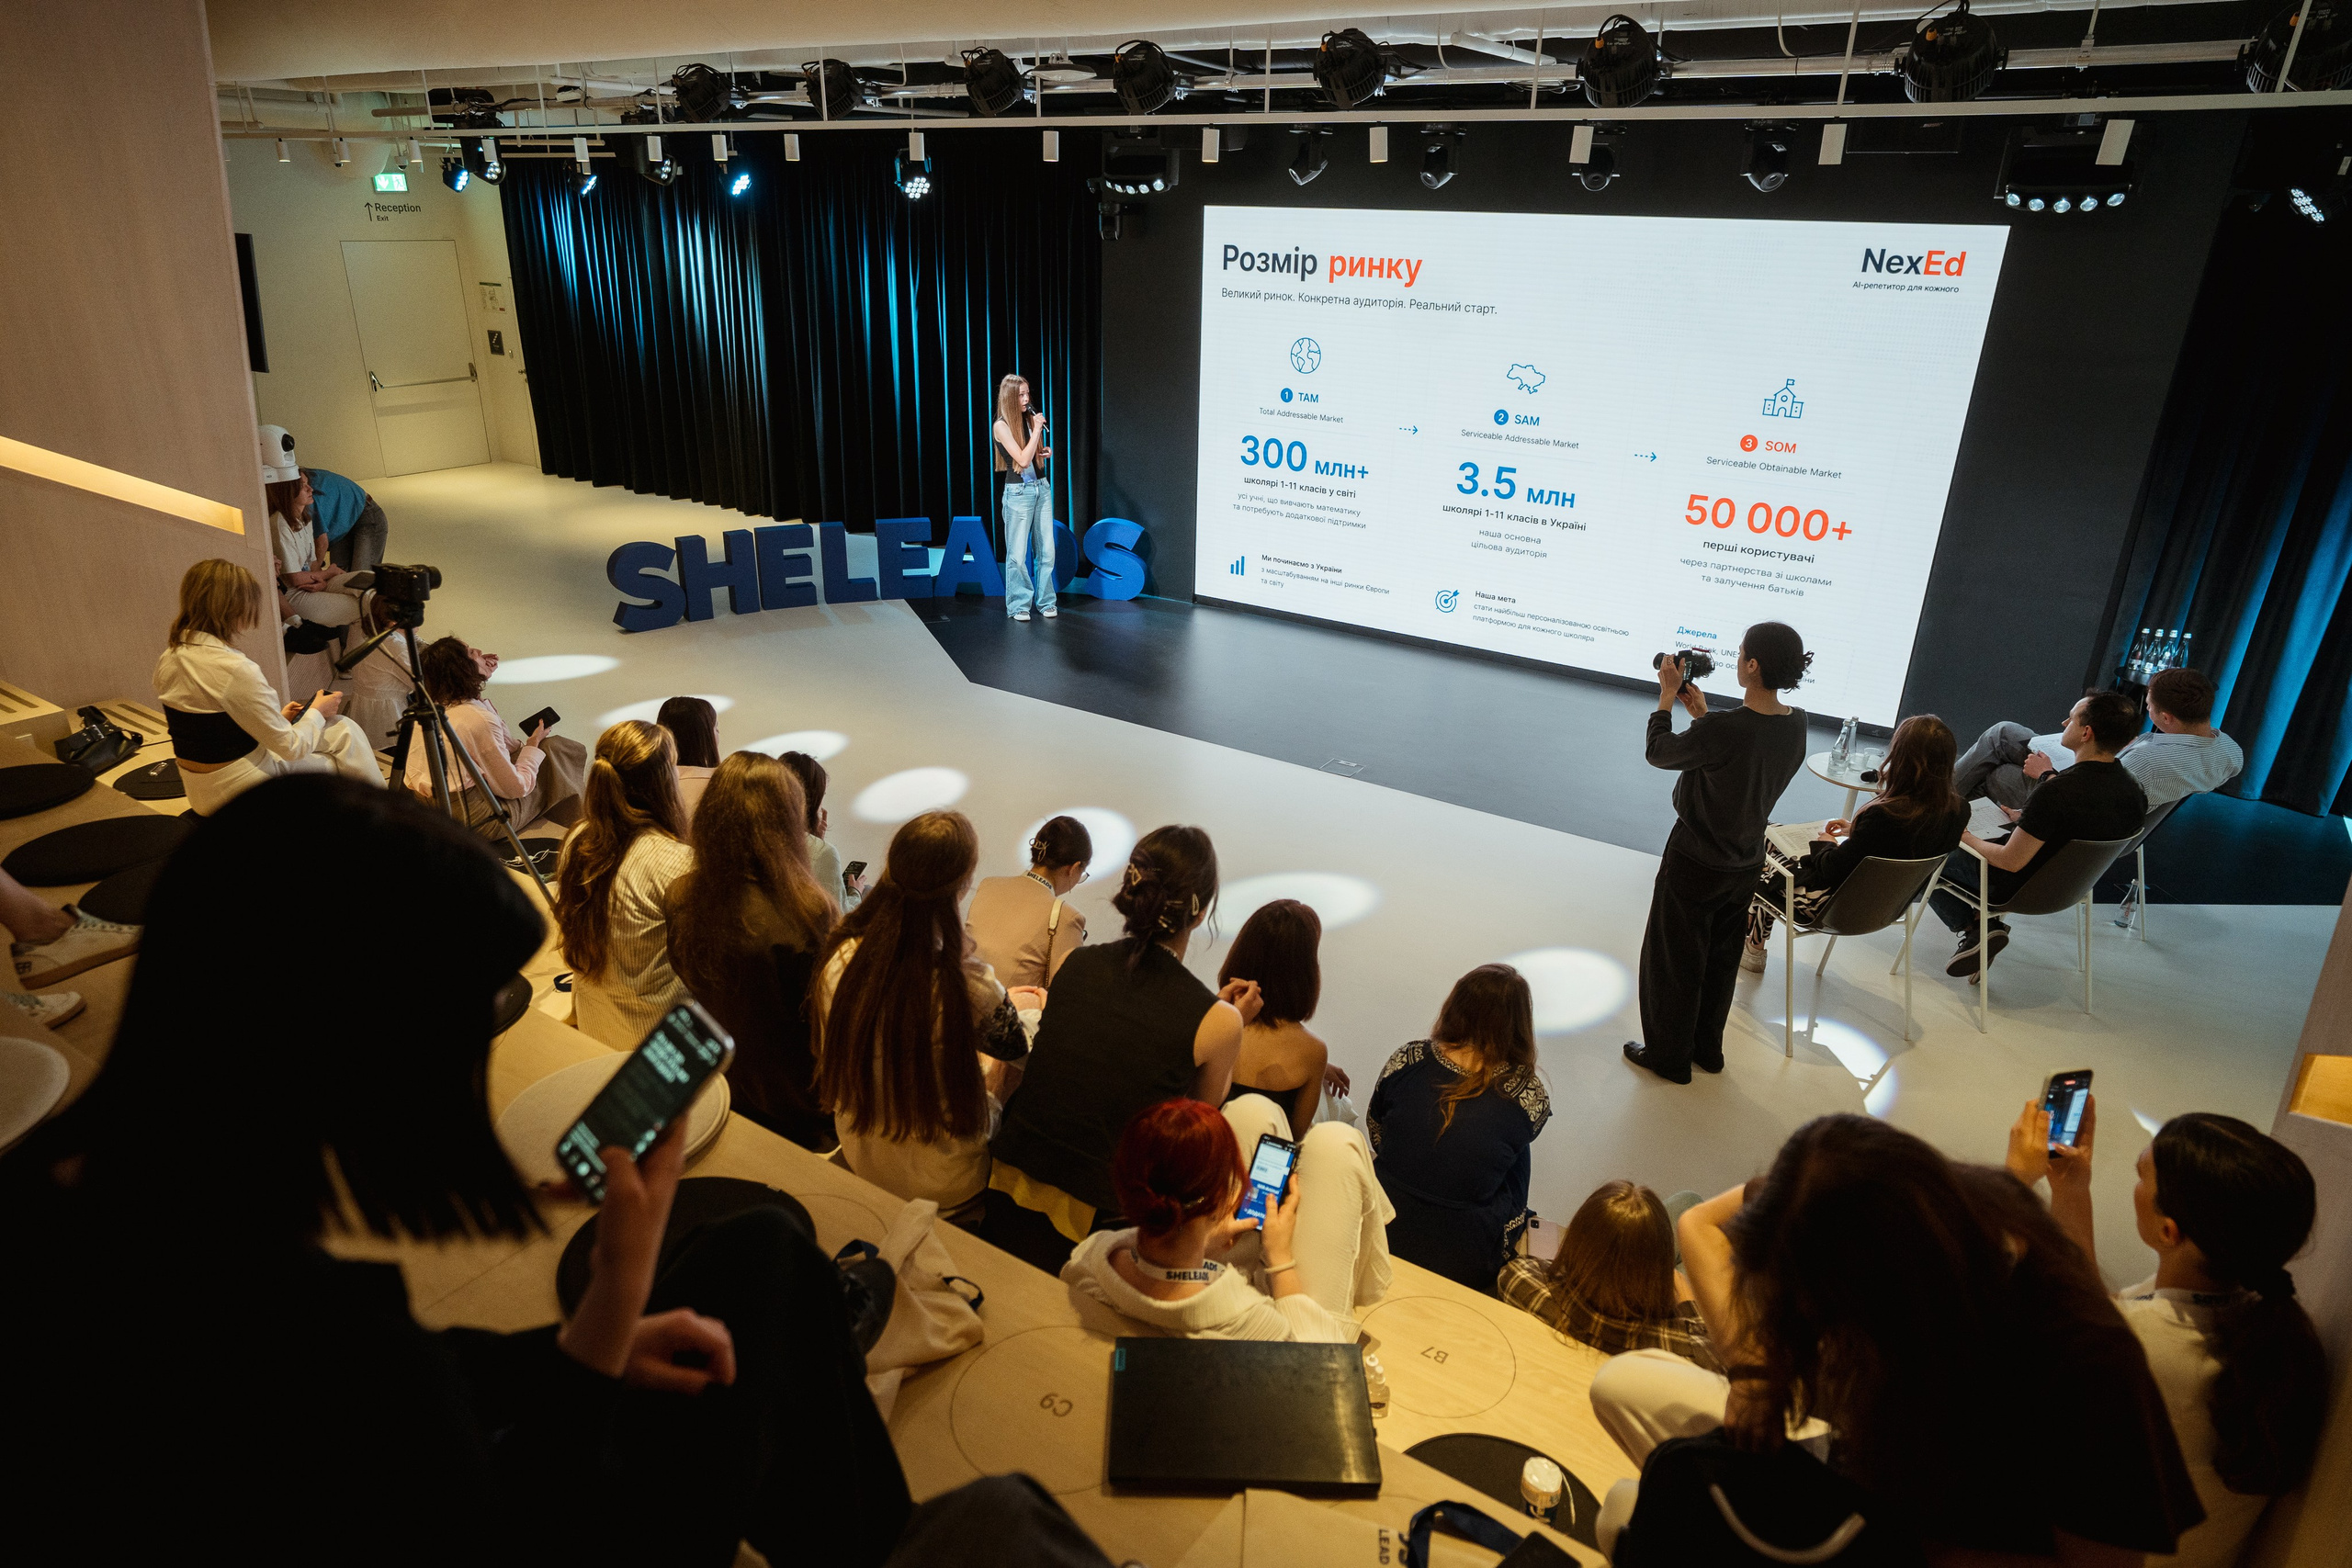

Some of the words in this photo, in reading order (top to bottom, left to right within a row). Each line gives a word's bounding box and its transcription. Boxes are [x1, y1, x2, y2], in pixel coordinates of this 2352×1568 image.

[375, 203, 421, 214] Reception
[1223, 244, 1317, 281] Розмір
[1329, 254, 1423, 288] ринку
[1861, 248, 1967, 276] NexEd
[1852, 281, 1905, 291] AI-репетитор
[1907, 284, 1922, 292] для
[1924, 285, 1959, 293] кожного
[1221, 288, 1261, 301] Великий
[1263, 290, 1295, 303] ринок.
[1298, 291, 1351, 308] Конкретна
[1353, 296, 1407, 309] аудиторія.
[1409, 298, 1461, 313] Реальний
[1464, 302, 1498, 315] старт.
[1298, 392, 1319, 403] TAM
[1259, 407, 1275, 416] Total
[1277, 410, 1317, 421] Addressable
[1319, 414, 1344, 423] Market
[1514, 414, 1540, 426] SAM
[1461, 428, 1503, 441] Serviceable
[1504, 434, 1551, 446] Addressable
[1552, 439, 1579, 449] Market
[1765, 440, 1797, 454] SOM
[1240, 434, 1307, 472] 300
[1315, 460, 1369, 479] млн+
[1706, 456, 1757, 469] Serviceable
[1758, 462, 1808, 475] Obtainable
[1809, 468, 1842, 479] Market
[1244, 477, 1278, 488] школярі
[1281, 480, 1297, 491] 1-11
[1299, 484, 1327, 494] класів
[1329, 489, 1335, 497] у
[1336, 489, 1356, 499] світі
[1456, 461, 1517, 500] 3.5
[1526, 486, 1577, 509] млн
[1238, 492, 1248, 501] усі
[1267, 496, 1279, 504] що
[1280, 499, 1315, 510] вивчають
[1317, 504, 1362, 517] математику
[1241, 505, 1284, 517] потребують
[1285, 511, 1327, 524] додаткової
[1328, 517, 1366, 529] підтримки
[1442, 503, 1483, 517] школярі
[1485, 509, 1504, 520] 1-11
[1507, 513, 1539, 525] класів
[1550, 518, 1587, 532] Україні
[1685, 493, 1736, 529] 50
[1747, 502, 1853, 541] 000+
[1478, 529, 1502, 538] наша
[1504, 533, 1542, 545] основна
[1471, 540, 1503, 552] цільова
[1505, 546, 1548, 559] аудиторія
[1702, 541, 1738, 553] перші
[1740, 546, 1815, 564] користувачі
[1261, 554, 1272, 562] Ми
[1273, 558, 1309, 569] починаємо
[1316, 563, 1342, 574] України
[1679, 557, 1708, 568] через
[1710, 562, 1772, 578] партнерства
[1775, 570, 1783, 580] зі
[1785, 572, 1832, 587] школами
[1266, 568, 1319, 582] масштабуванням
[1330, 579, 1343, 587] інші
[1344, 581, 1364, 590] ринки
[1365, 584, 1390, 595] Європи
[1269, 579, 1284, 588] світу
[1701, 574, 1712, 582] та
[1714, 577, 1766, 591] залучення
[1768, 583, 1804, 597] батьків
[1475, 591, 1496, 601] Наша
[1498, 595, 1516, 604] мета
[1472, 615, 1517, 628] платформою
[1532, 626, 1562, 637] кожного
[1563, 632, 1595, 642] школяра
[1474, 603, 1493, 613] стати
[1494, 606, 1526, 618] найбільш
[1527, 613, 1591, 630] персоналізованою
[1592, 625, 1630, 637] освітньою
[1677, 626, 1717, 639] Джерела
[1420, 1346, 1450, 1365] B7
[1039, 1393, 1073, 1418] C9
